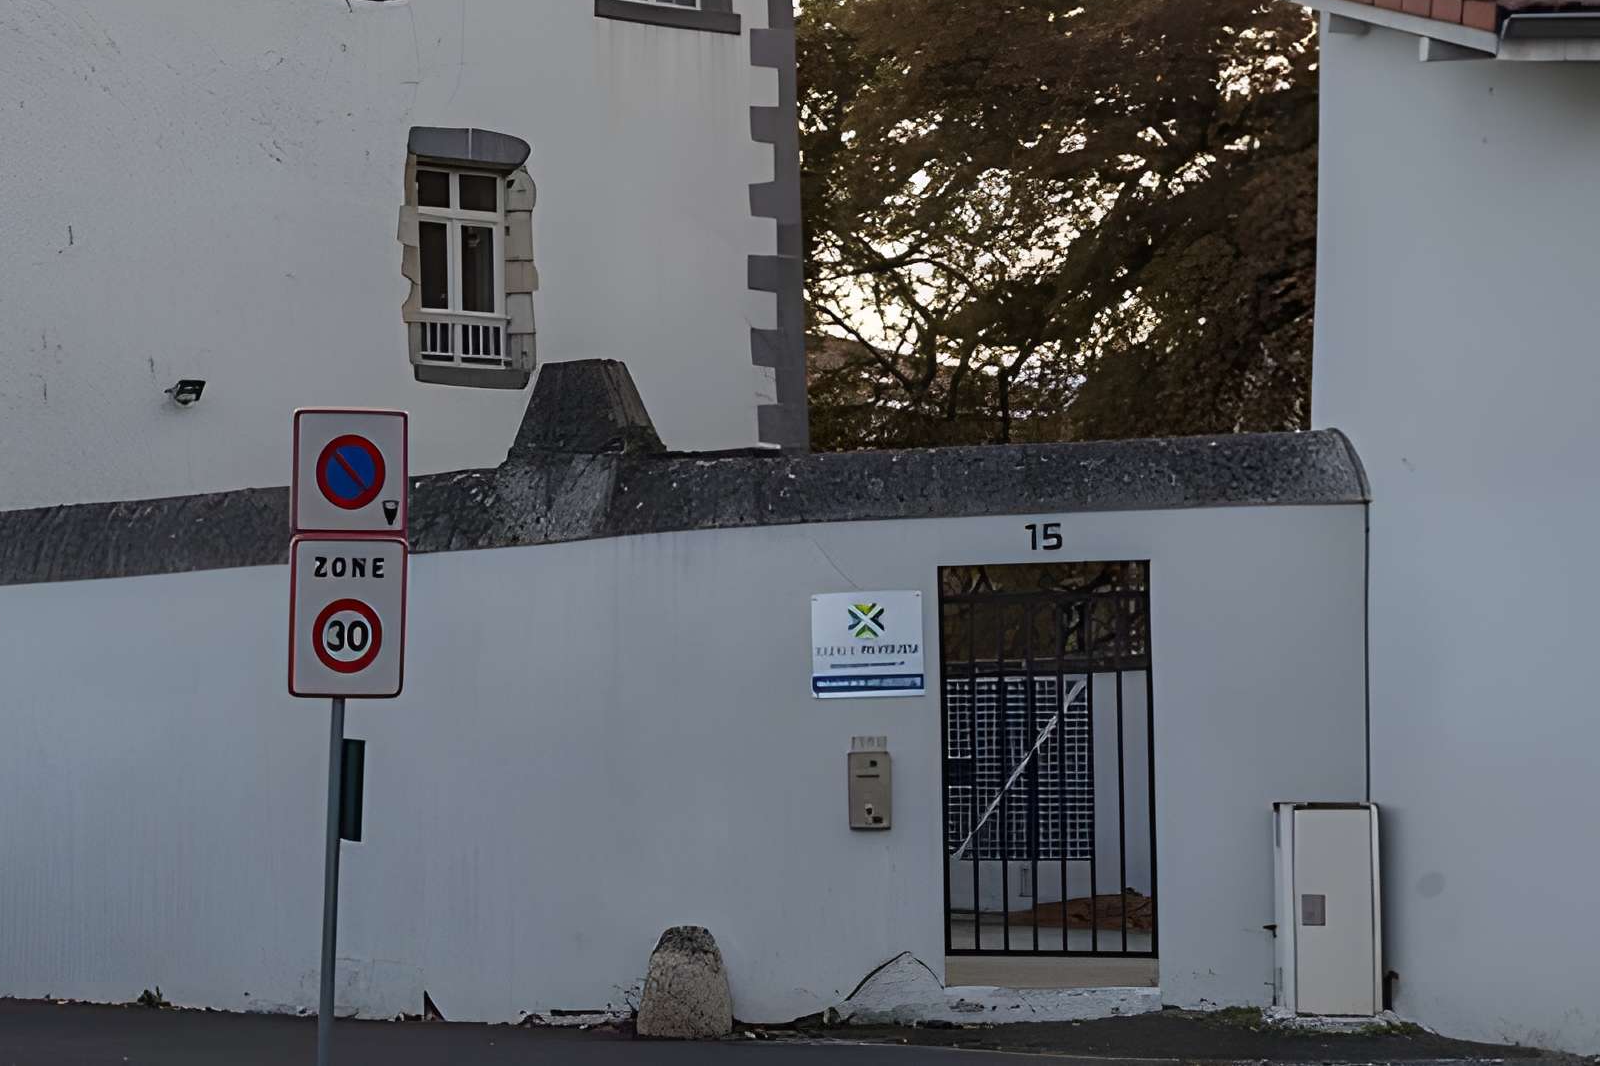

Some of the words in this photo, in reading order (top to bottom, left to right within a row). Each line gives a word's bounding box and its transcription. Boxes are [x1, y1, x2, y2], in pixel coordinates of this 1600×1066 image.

[1025, 523, 1062, 550] 15
[314, 556, 385, 578] ZONE
[327, 620, 369, 652] 30
